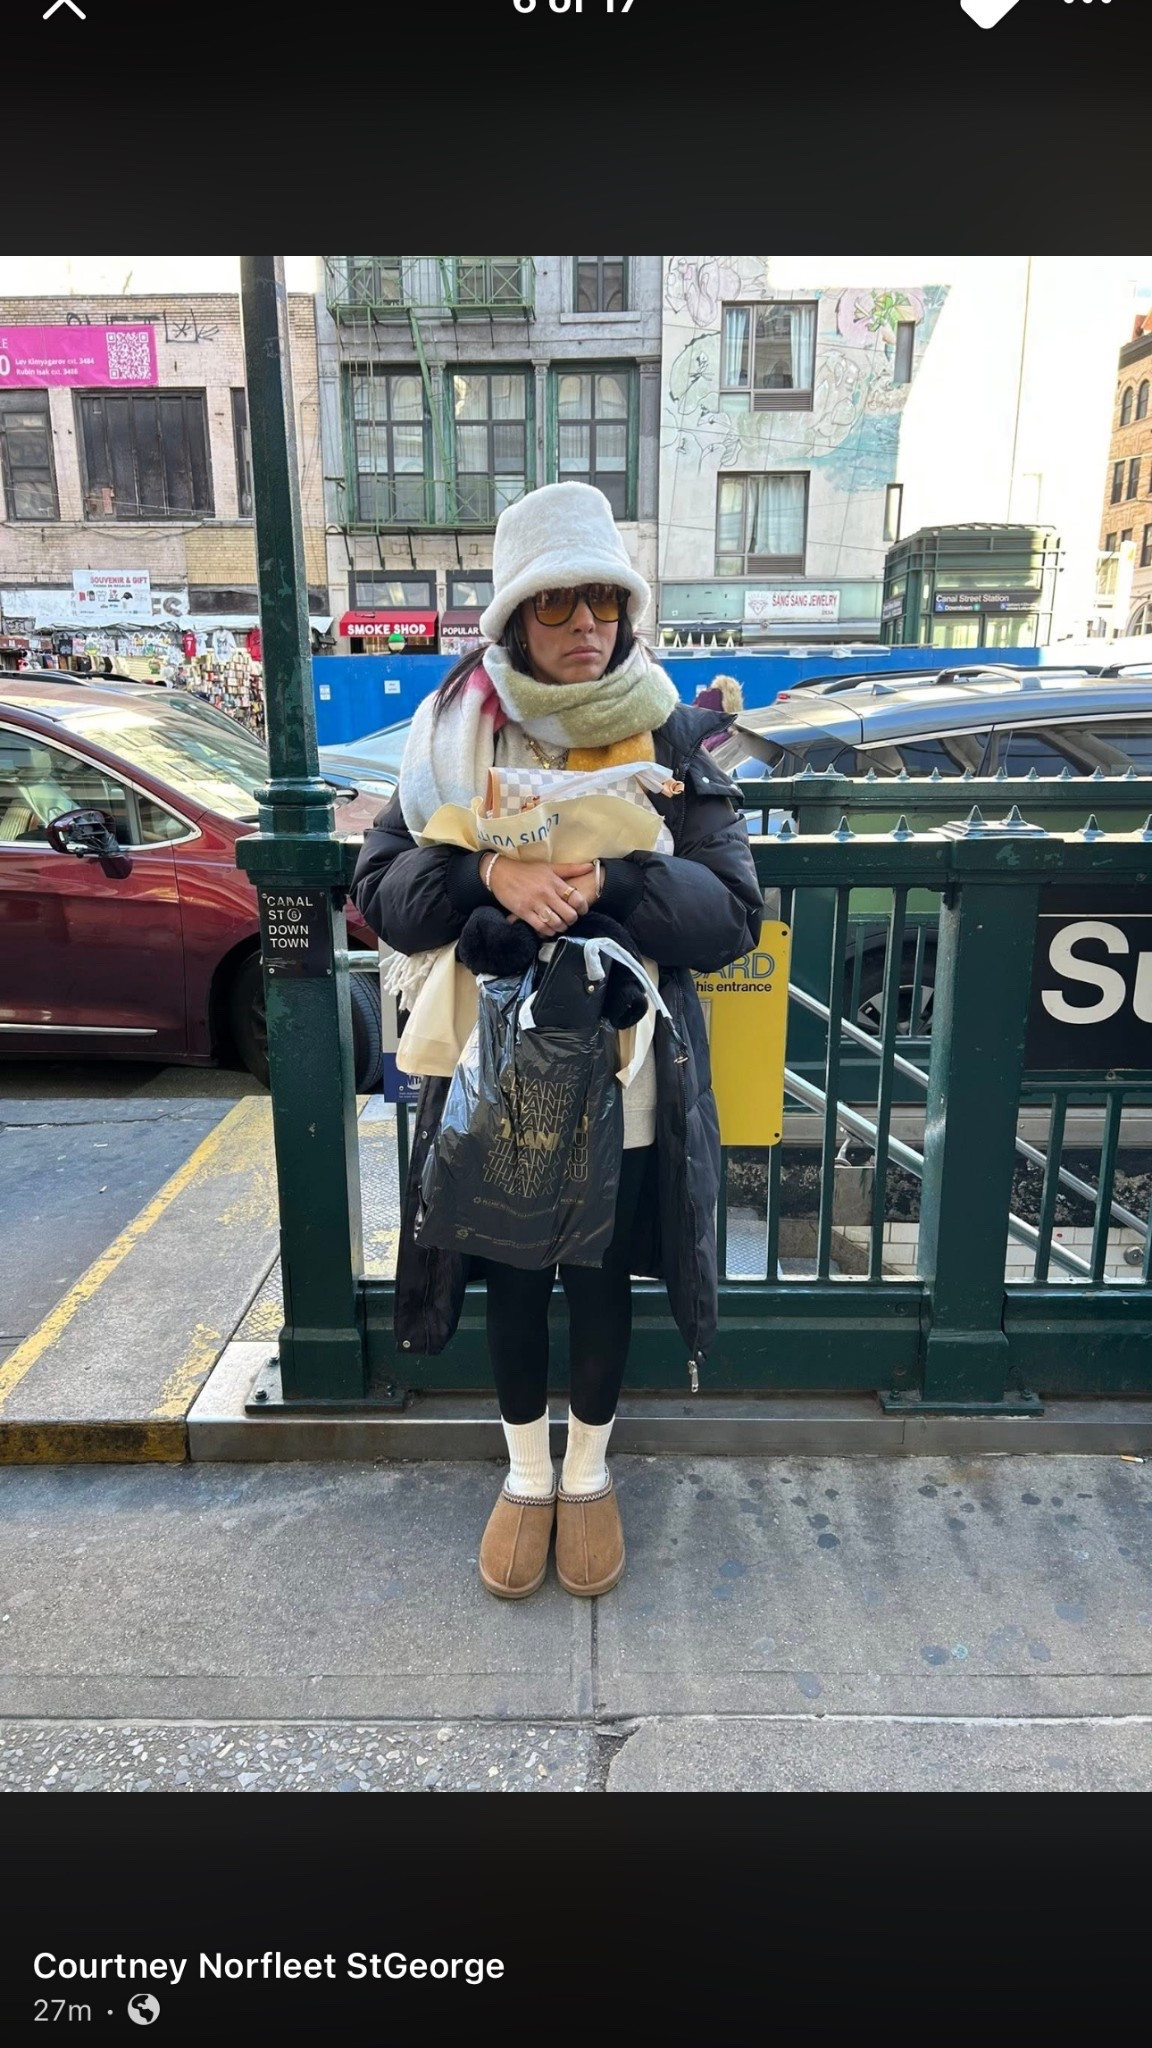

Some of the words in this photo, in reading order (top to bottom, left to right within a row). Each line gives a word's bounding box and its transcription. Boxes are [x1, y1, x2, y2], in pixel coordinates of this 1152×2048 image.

[0, 338, 8, 349] E
[90, 576, 124, 584] SOUVENIR
[126, 576, 131, 584] &
[132, 576, 148, 584] GIFT
[772, 594, 789, 607] SANG
[790, 594, 807, 607] SANG
[808, 594, 837, 607] JEWELRY
[936, 594, 957, 603] Canal
[959, 594, 982, 603] Street
[983, 594, 1009, 603] Station
[347, 623, 390, 635] SMOKE
[393, 623, 427, 635] SHOP
[442, 627, 479, 635] POPULAR
[267, 896, 313, 907] CANAL
[268, 910, 284, 920] ST
[268, 925, 309, 935] DOWN
[270, 938, 309, 948] TOWN
[716, 981, 772, 992] entrance
